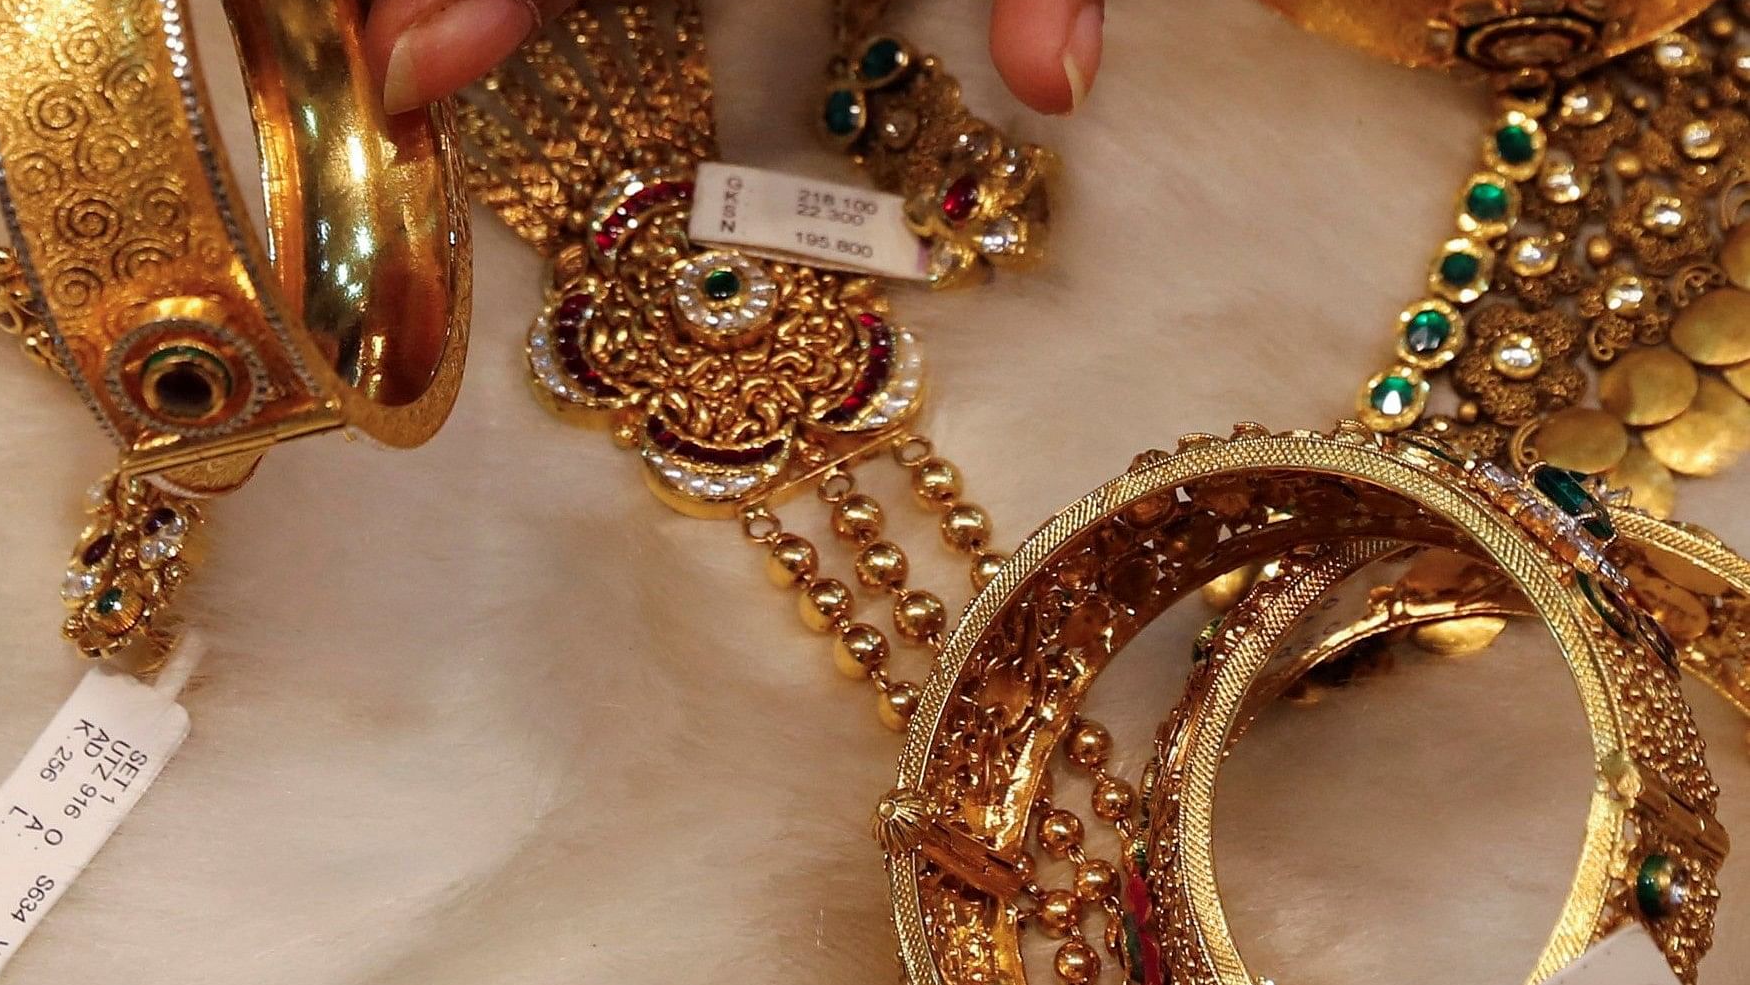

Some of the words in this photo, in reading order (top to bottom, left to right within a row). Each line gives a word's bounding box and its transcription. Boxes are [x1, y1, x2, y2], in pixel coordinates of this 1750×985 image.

[84, 729, 110, 758] AD
[92, 739, 131, 781] UTZ
[40, 746, 73, 782] 256
[112, 749, 147, 791] SET
[64, 783, 97, 819] 916
[99, 793, 115, 804] 1
[11, 875, 55, 924] S634
